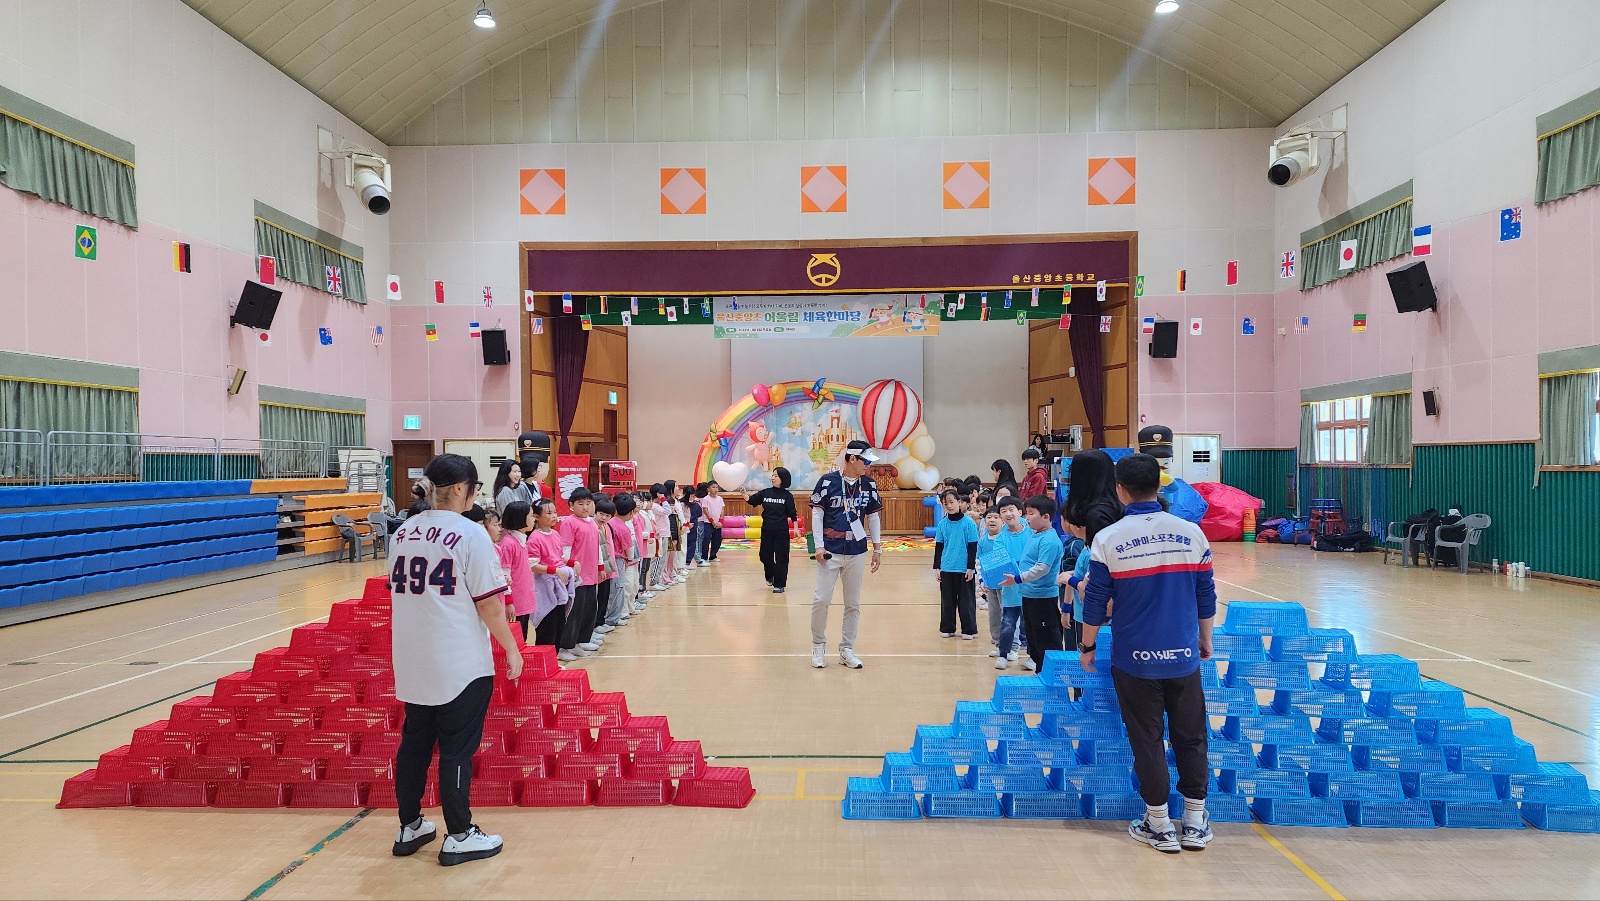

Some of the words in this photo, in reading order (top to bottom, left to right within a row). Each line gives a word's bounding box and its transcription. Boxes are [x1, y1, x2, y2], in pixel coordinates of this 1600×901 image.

[1012, 273, 1095, 283] 울산중앙초등학교
[716, 312, 762, 322] 울산중앙초
[764, 311, 799, 323] 어울림
[802, 310, 861, 322] 체육한마당
[396, 526, 462, 550] 유스아이
[1115, 533, 1191, 553] 유스아이스포츠클럽
[391, 555, 457, 595] 494
